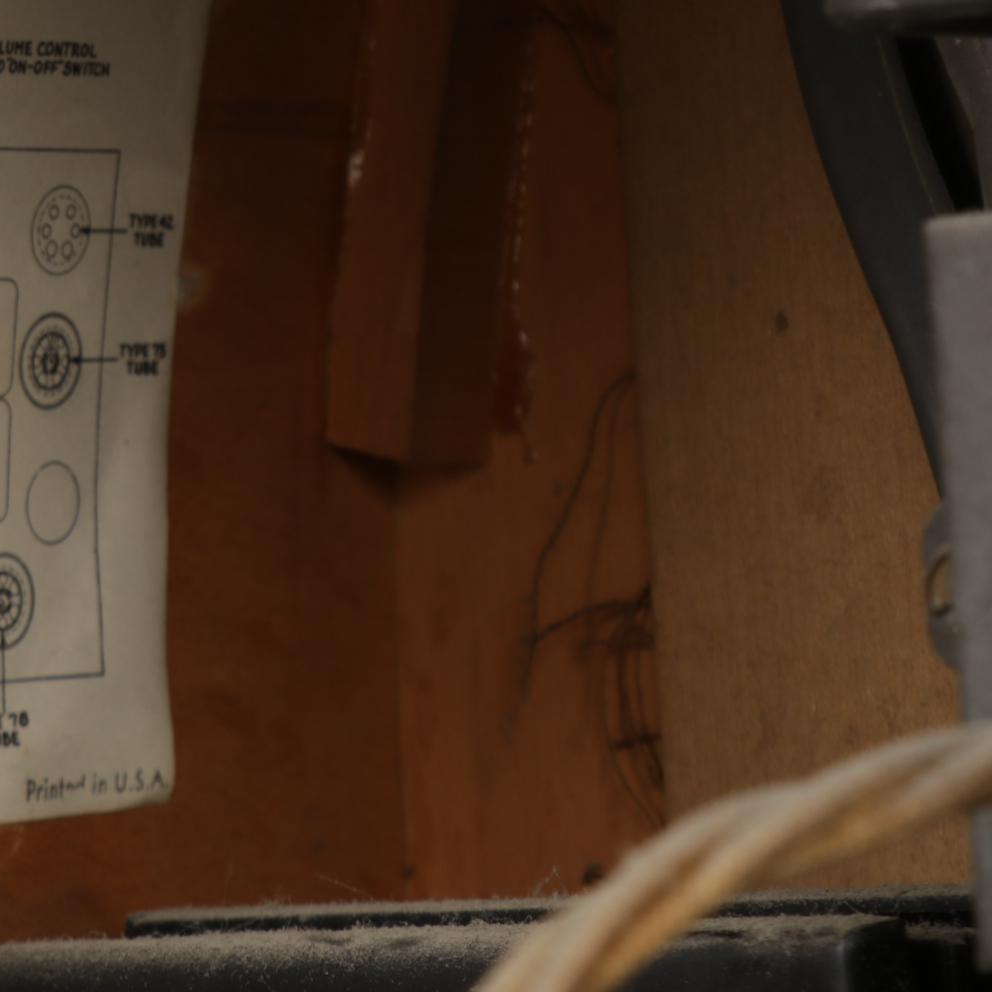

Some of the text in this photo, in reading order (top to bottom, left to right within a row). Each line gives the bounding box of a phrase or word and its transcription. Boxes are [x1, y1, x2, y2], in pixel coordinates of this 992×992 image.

[36, 40, 97, 59] CONTROL
[129, 213, 157, 229] TYPE
[134, 232, 164, 248] TUBE
[119, 342, 148, 358] TYPE
[127, 361, 159, 376] TUBE
[91, 772, 107, 795] in
